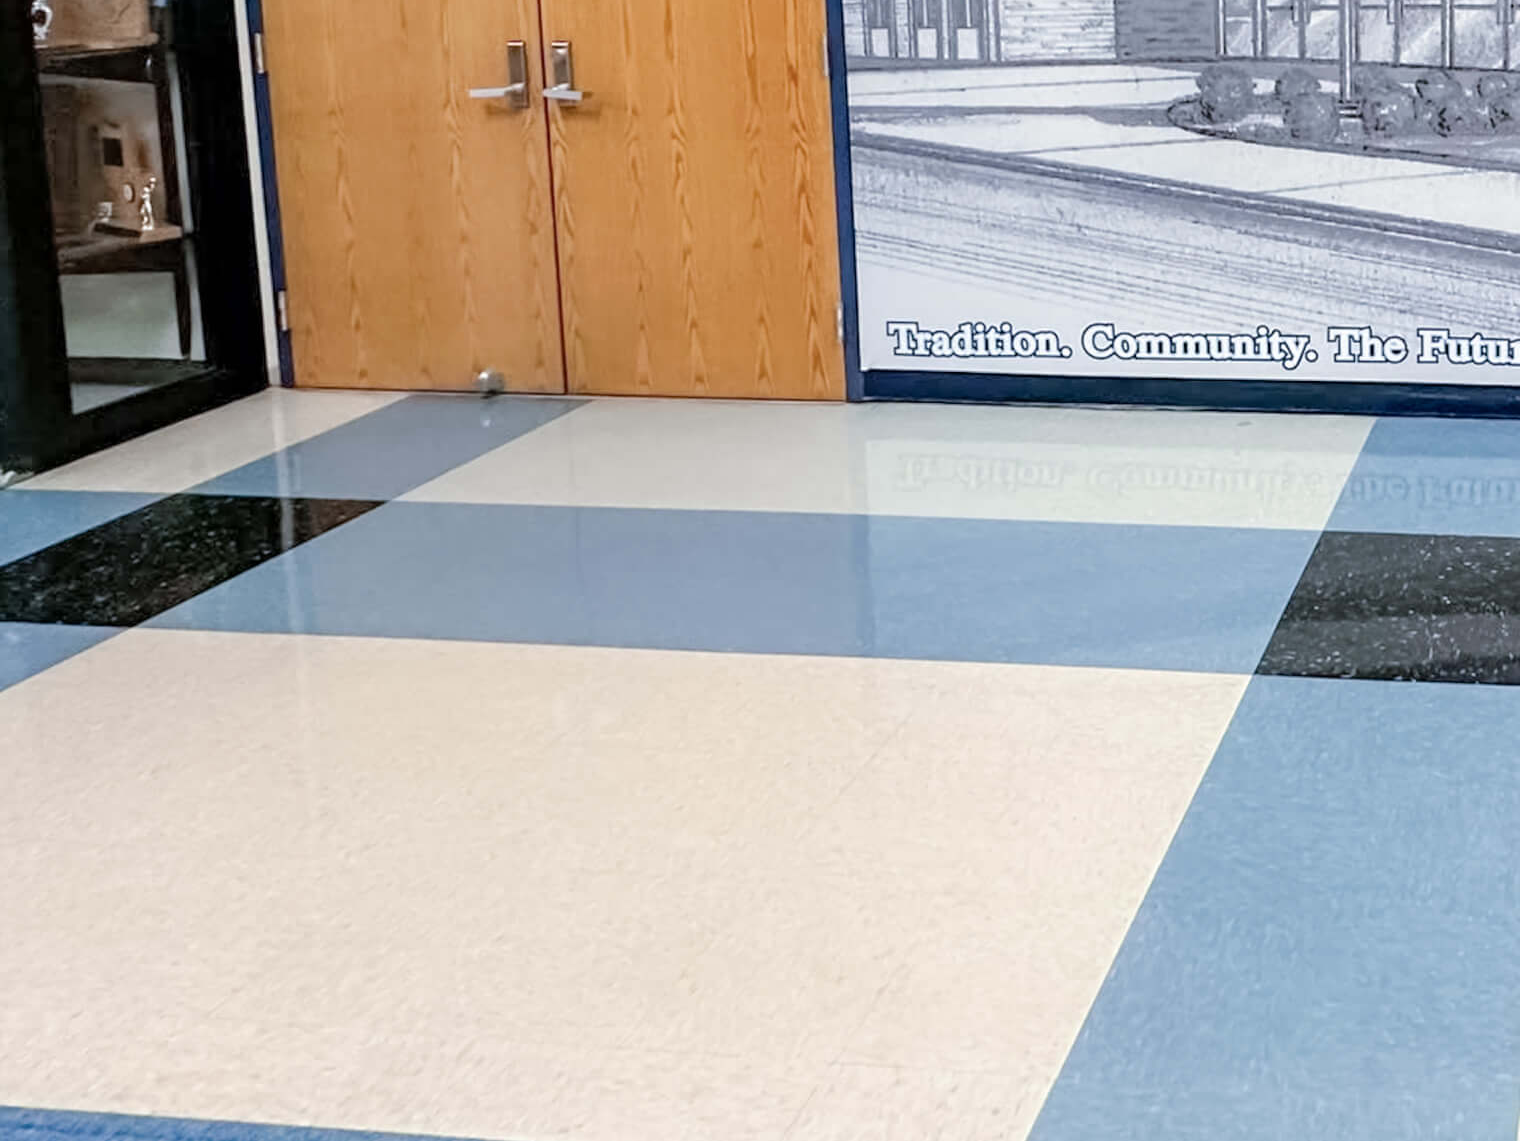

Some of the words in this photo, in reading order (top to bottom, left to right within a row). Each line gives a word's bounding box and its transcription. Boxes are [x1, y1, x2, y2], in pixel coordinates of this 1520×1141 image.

[885, 321, 1073, 359] Tradition.
[1081, 323, 1319, 370] Community.
[1327, 325, 1409, 364] The
